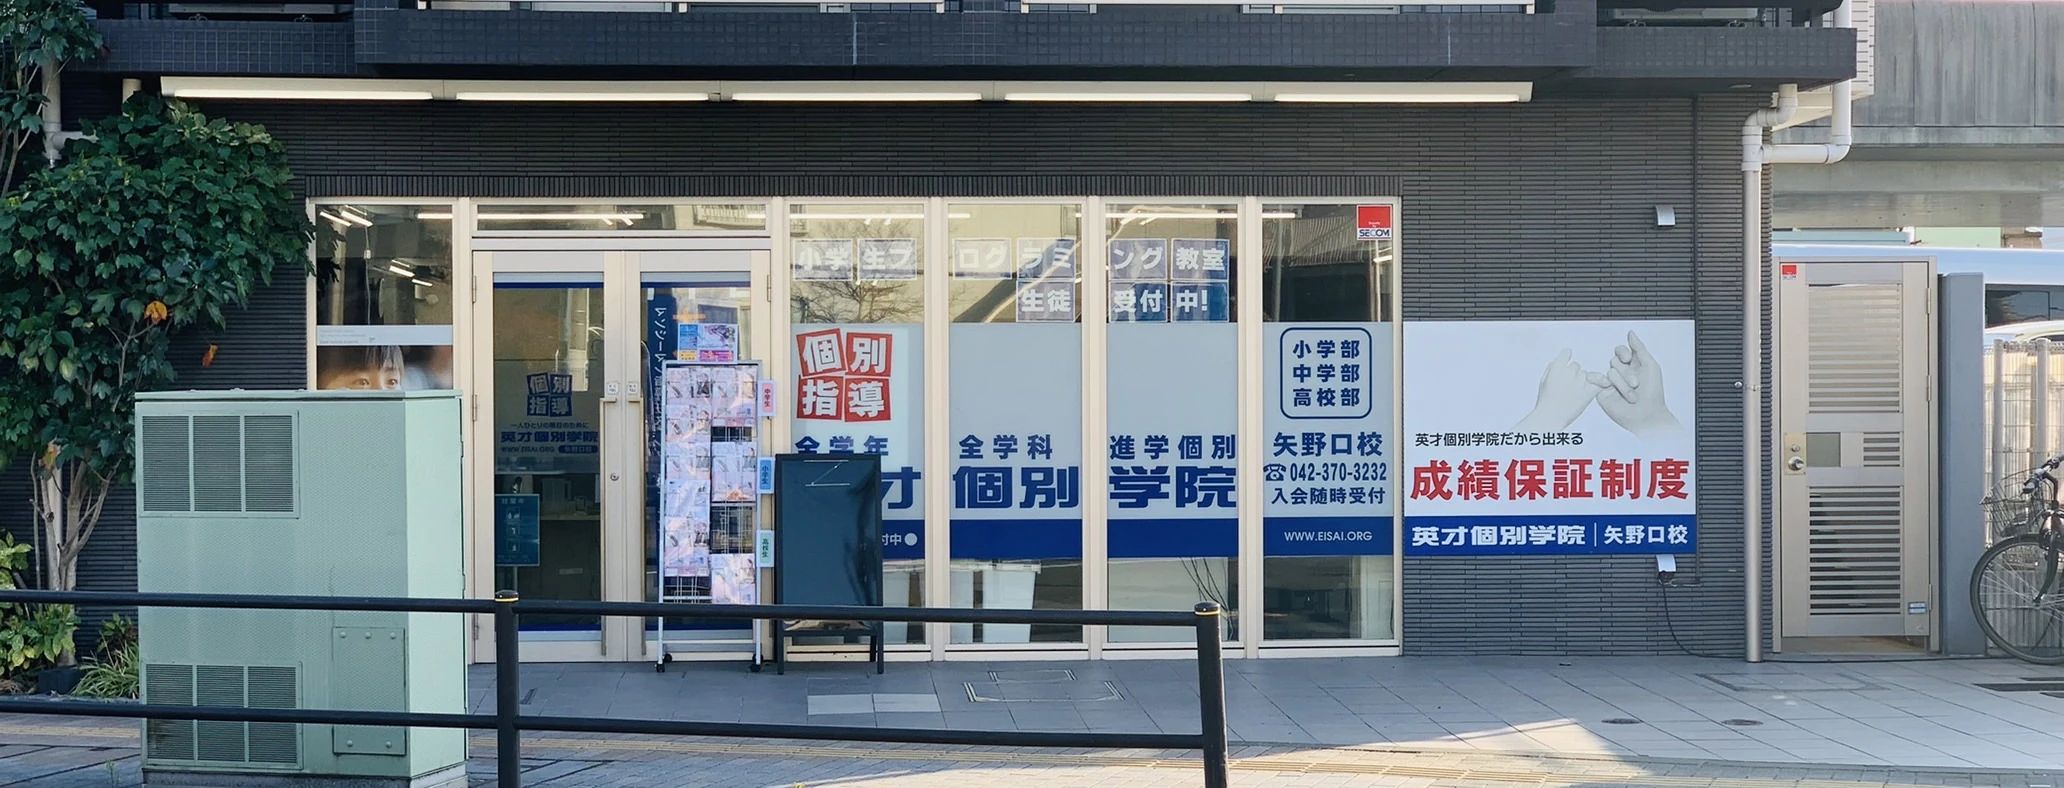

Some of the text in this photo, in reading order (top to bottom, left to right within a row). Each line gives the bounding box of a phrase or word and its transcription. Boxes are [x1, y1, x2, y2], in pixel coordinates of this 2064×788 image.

[1359, 229, 1390, 237] SECOM
[802, 335, 887, 374] 個別
[1292, 340, 1360, 360] 小学部
[1292, 364, 1360, 383] 中学部
[802, 380, 885, 418] 指導
[1292, 388, 1360, 407] 高校部
[959, 434, 1054, 460] 全学科
[1109, 434, 1237, 460] 進学個別
[1272, 432, 1383, 457] 矢野口校
[1415, 432, 1584, 447] 英才個別学院だから出来る
[1290, 462, 1387, 481] 042-370-3232
[1409, 458, 1690, 501] 成績保証制度
[1271, 487, 1386, 505] 入会随時受付
[1284, 530, 1373, 541] WWW.EISAI.ORG
[1411, 524, 1689, 546] 英才個別学院 矢野口校
